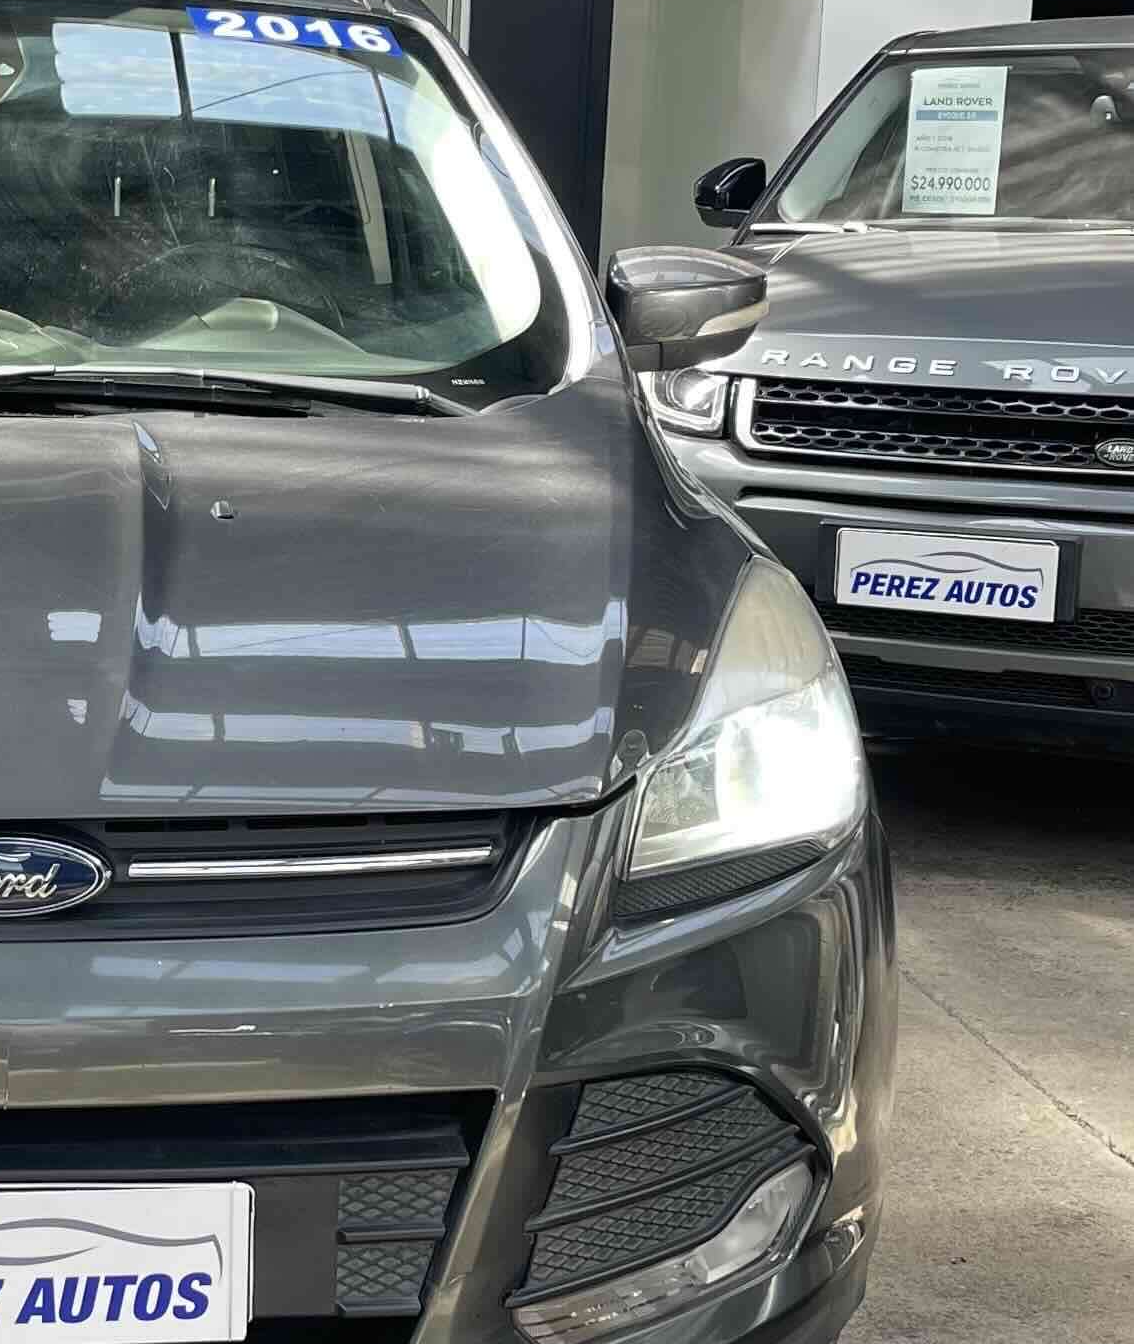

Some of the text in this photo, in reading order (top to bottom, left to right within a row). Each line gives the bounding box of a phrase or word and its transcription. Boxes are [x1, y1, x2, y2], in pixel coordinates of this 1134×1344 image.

[206, 10, 391, 53] 2016
[924, 97, 993, 106] LAND ROVER
[761, 348, 958, 377] RANGE
[850, 571, 1038, 609] PEREZ AUTOS
[15, 1272, 212, 1324] AUTOS
